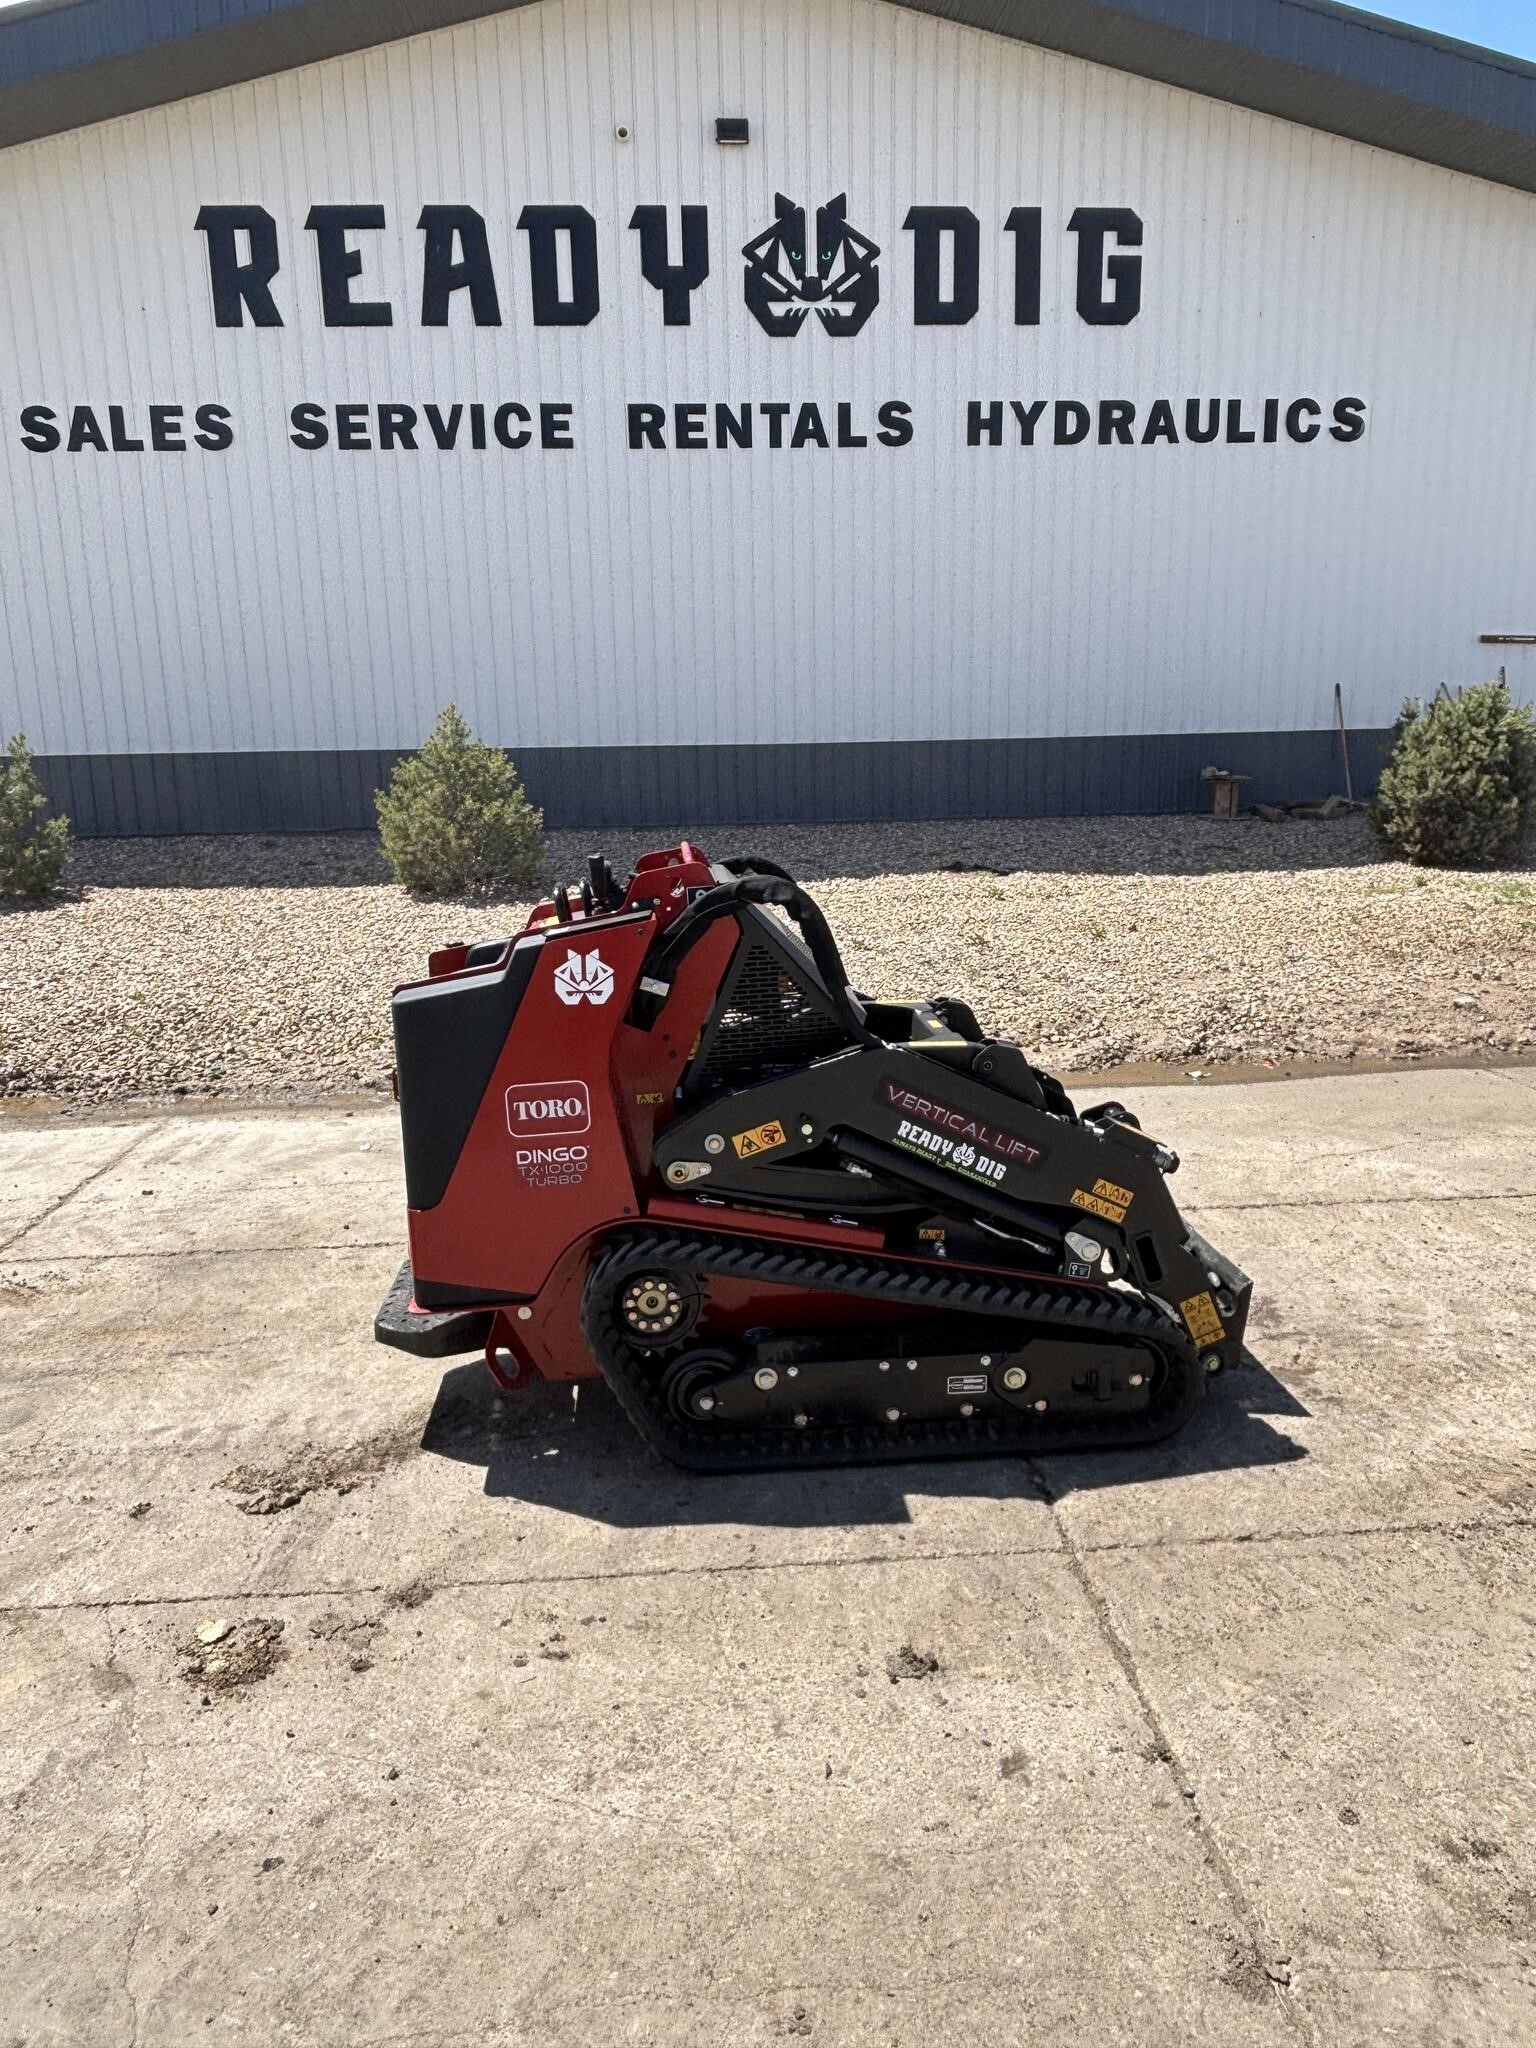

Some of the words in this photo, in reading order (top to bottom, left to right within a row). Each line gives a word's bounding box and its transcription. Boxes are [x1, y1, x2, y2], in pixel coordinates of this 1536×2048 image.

[193, 204, 710, 327] READY
[902, 206, 1144, 326] DIG
[20, 405, 234, 453] SALES
[290, 402, 575, 450] SERVICE
[627, 400, 914, 449] RENTALS
[966, 396, 1367, 446] HYDRAULICS
[513, 1097, 583, 1120] TORO
[889, 1085, 989, 1143] VERTICAL
[995, 1133, 1040, 1163] LIFT
[516, 1145, 588, 1165] DINGO
[897, 1120, 954, 1156] READY
[975, 1155, 1007, 1180] DIG
[526, 1174, 582, 1188] TURBO
